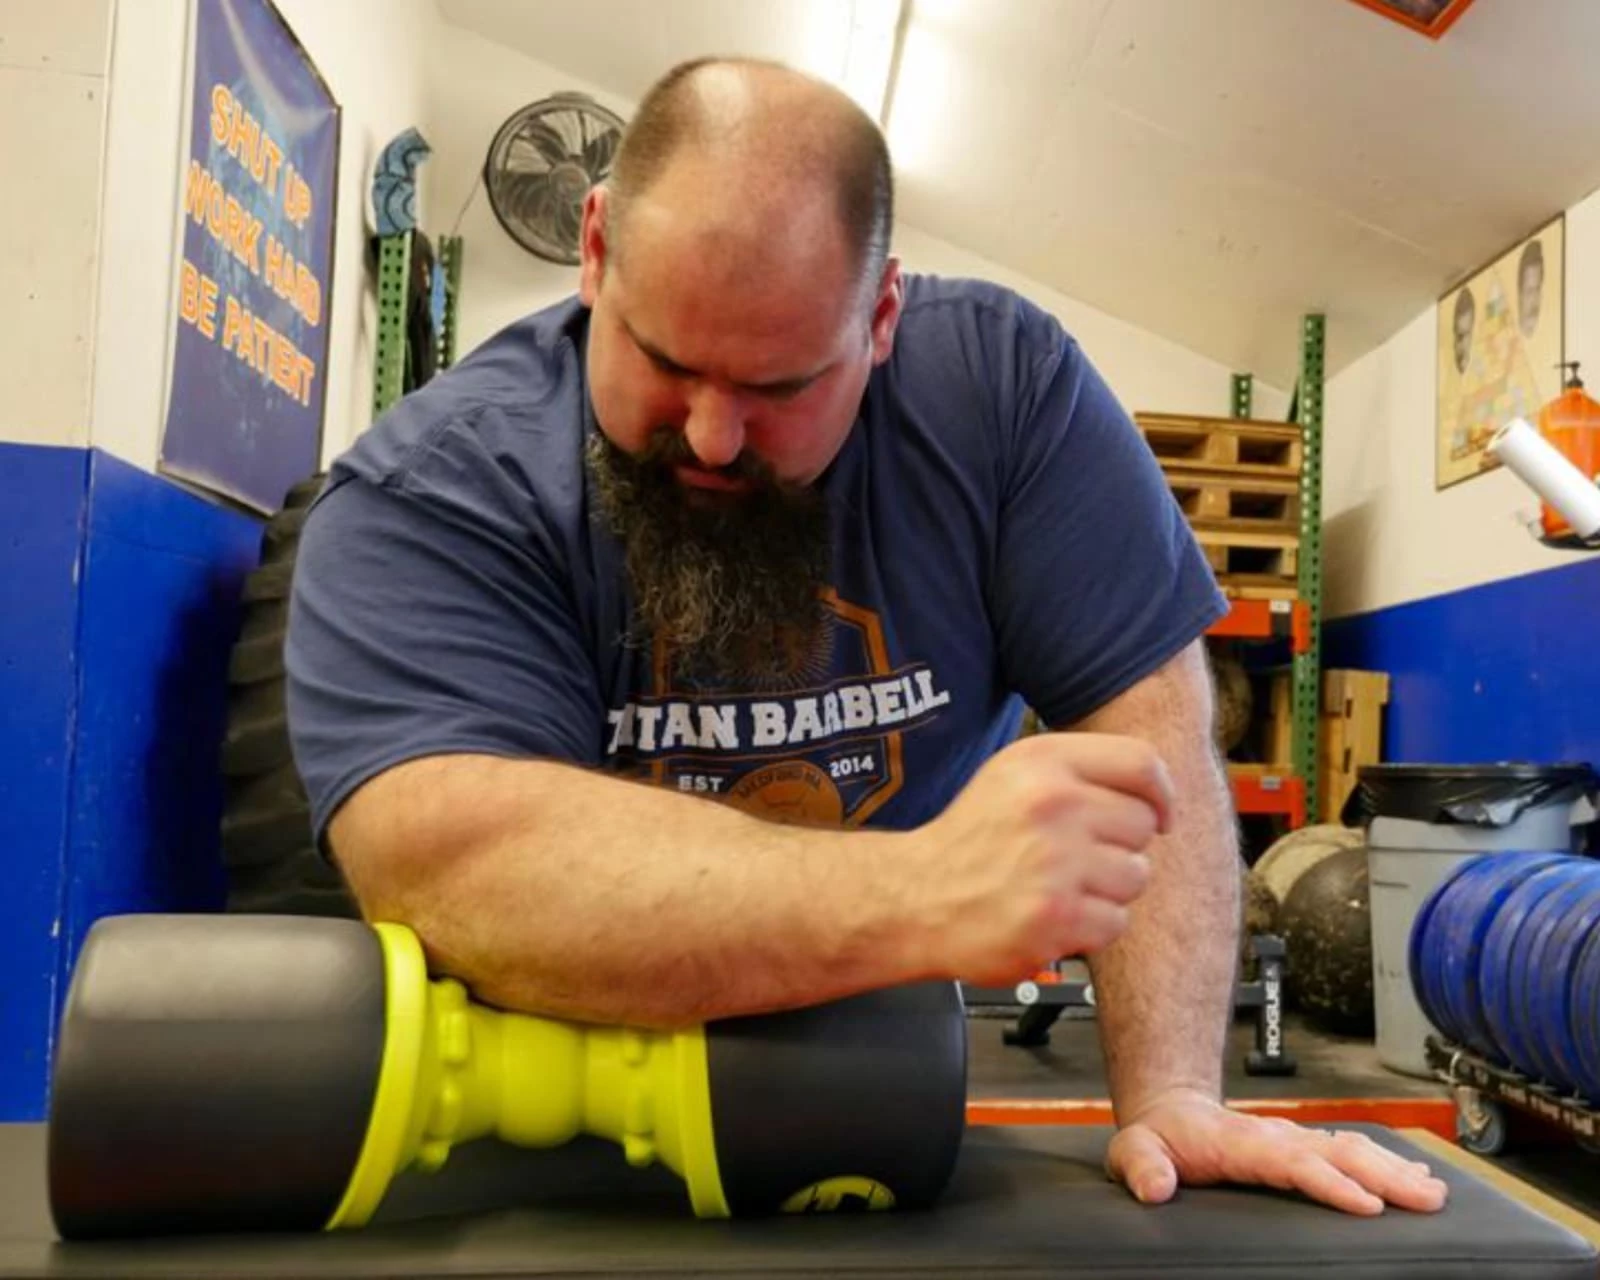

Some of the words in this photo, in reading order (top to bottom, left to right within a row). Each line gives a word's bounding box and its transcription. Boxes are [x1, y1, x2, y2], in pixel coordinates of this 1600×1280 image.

[210, 85, 283, 196] SHUT
[285, 164, 312, 230] UP
[185, 161, 262, 274] WORK
[180, 260, 218, 340] BE
[752, 671, 949, 747] BARBELL
[678, 776, 723, 792] EST
[830, 755, 874, 777] 2014
[1265, 981, 1280, 1056] ROGUE
